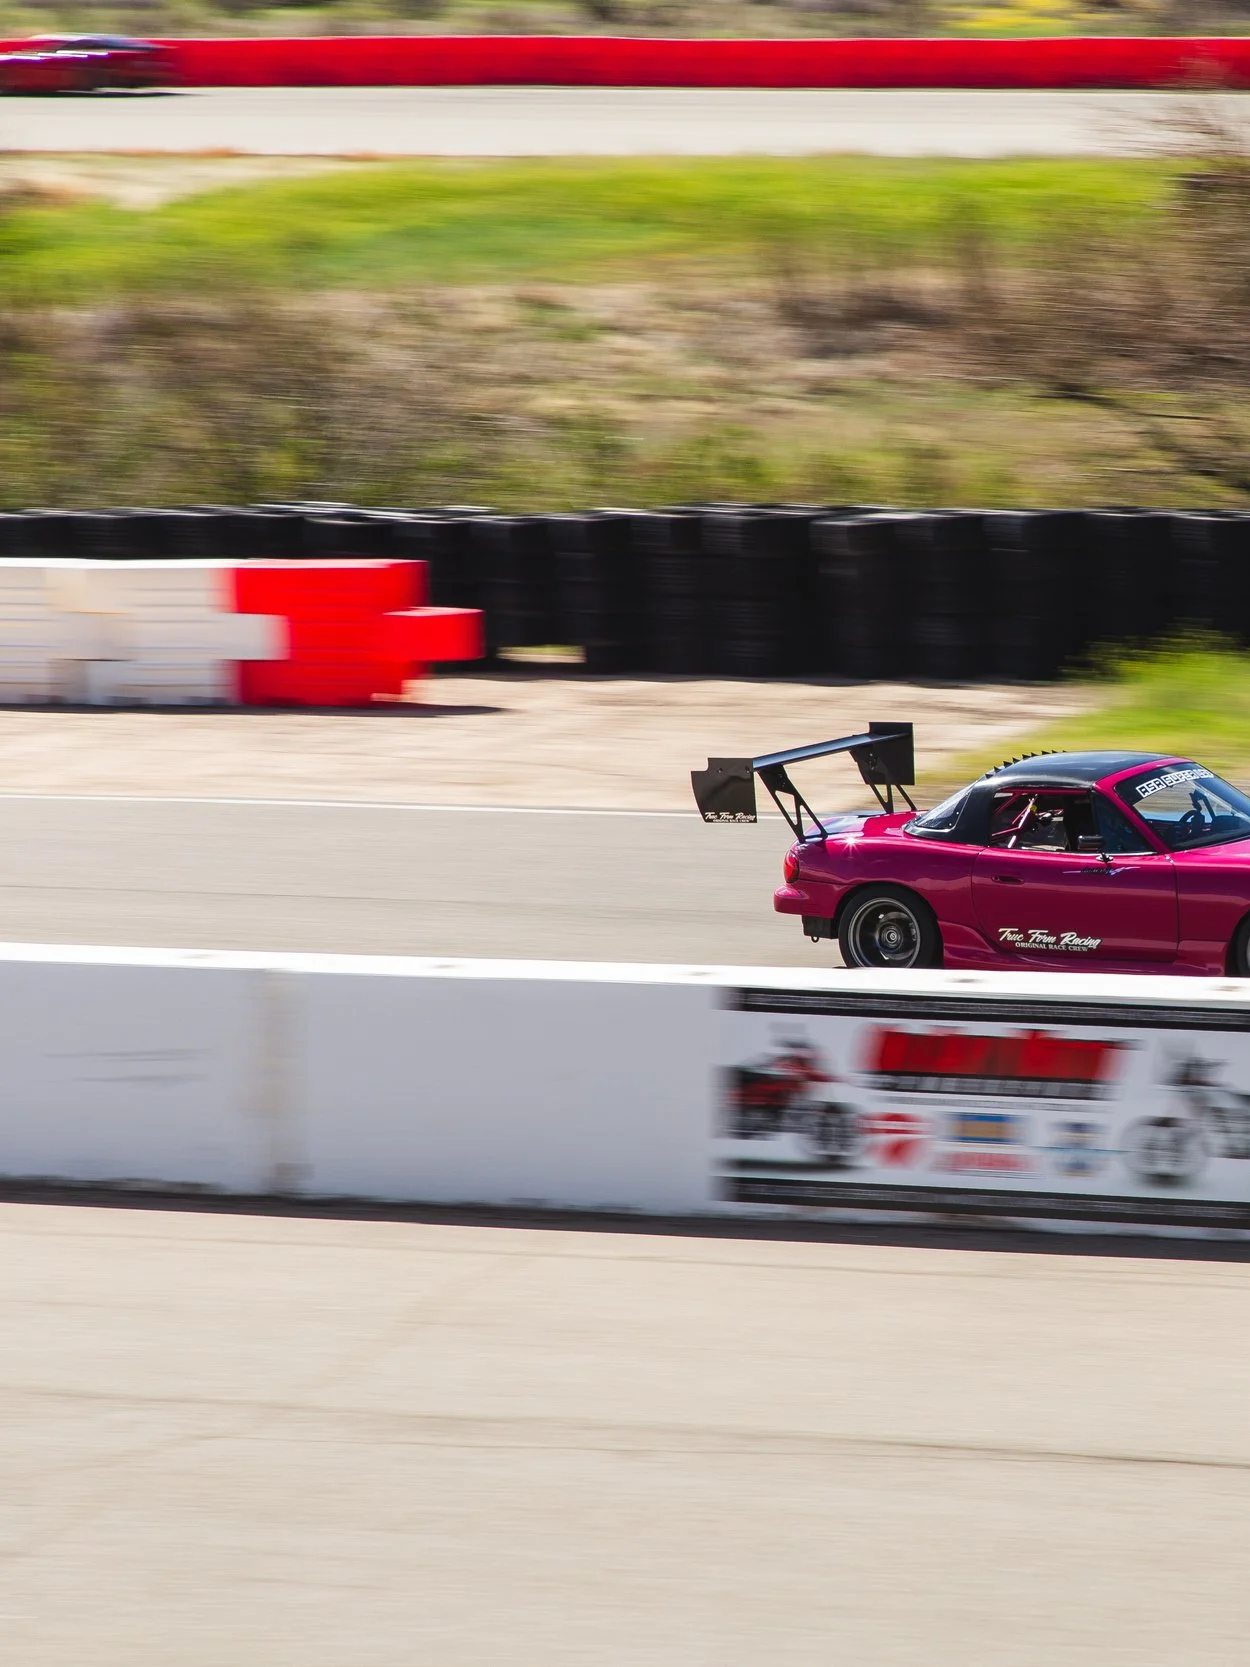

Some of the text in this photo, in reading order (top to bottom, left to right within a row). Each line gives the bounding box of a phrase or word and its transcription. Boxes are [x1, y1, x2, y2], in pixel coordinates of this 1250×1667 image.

[998, 928, 1102, 949] True Form Racing
[1015, 941, 1047, 950] ORIGINAL
[1048, 943, 1067, 951] RACE
